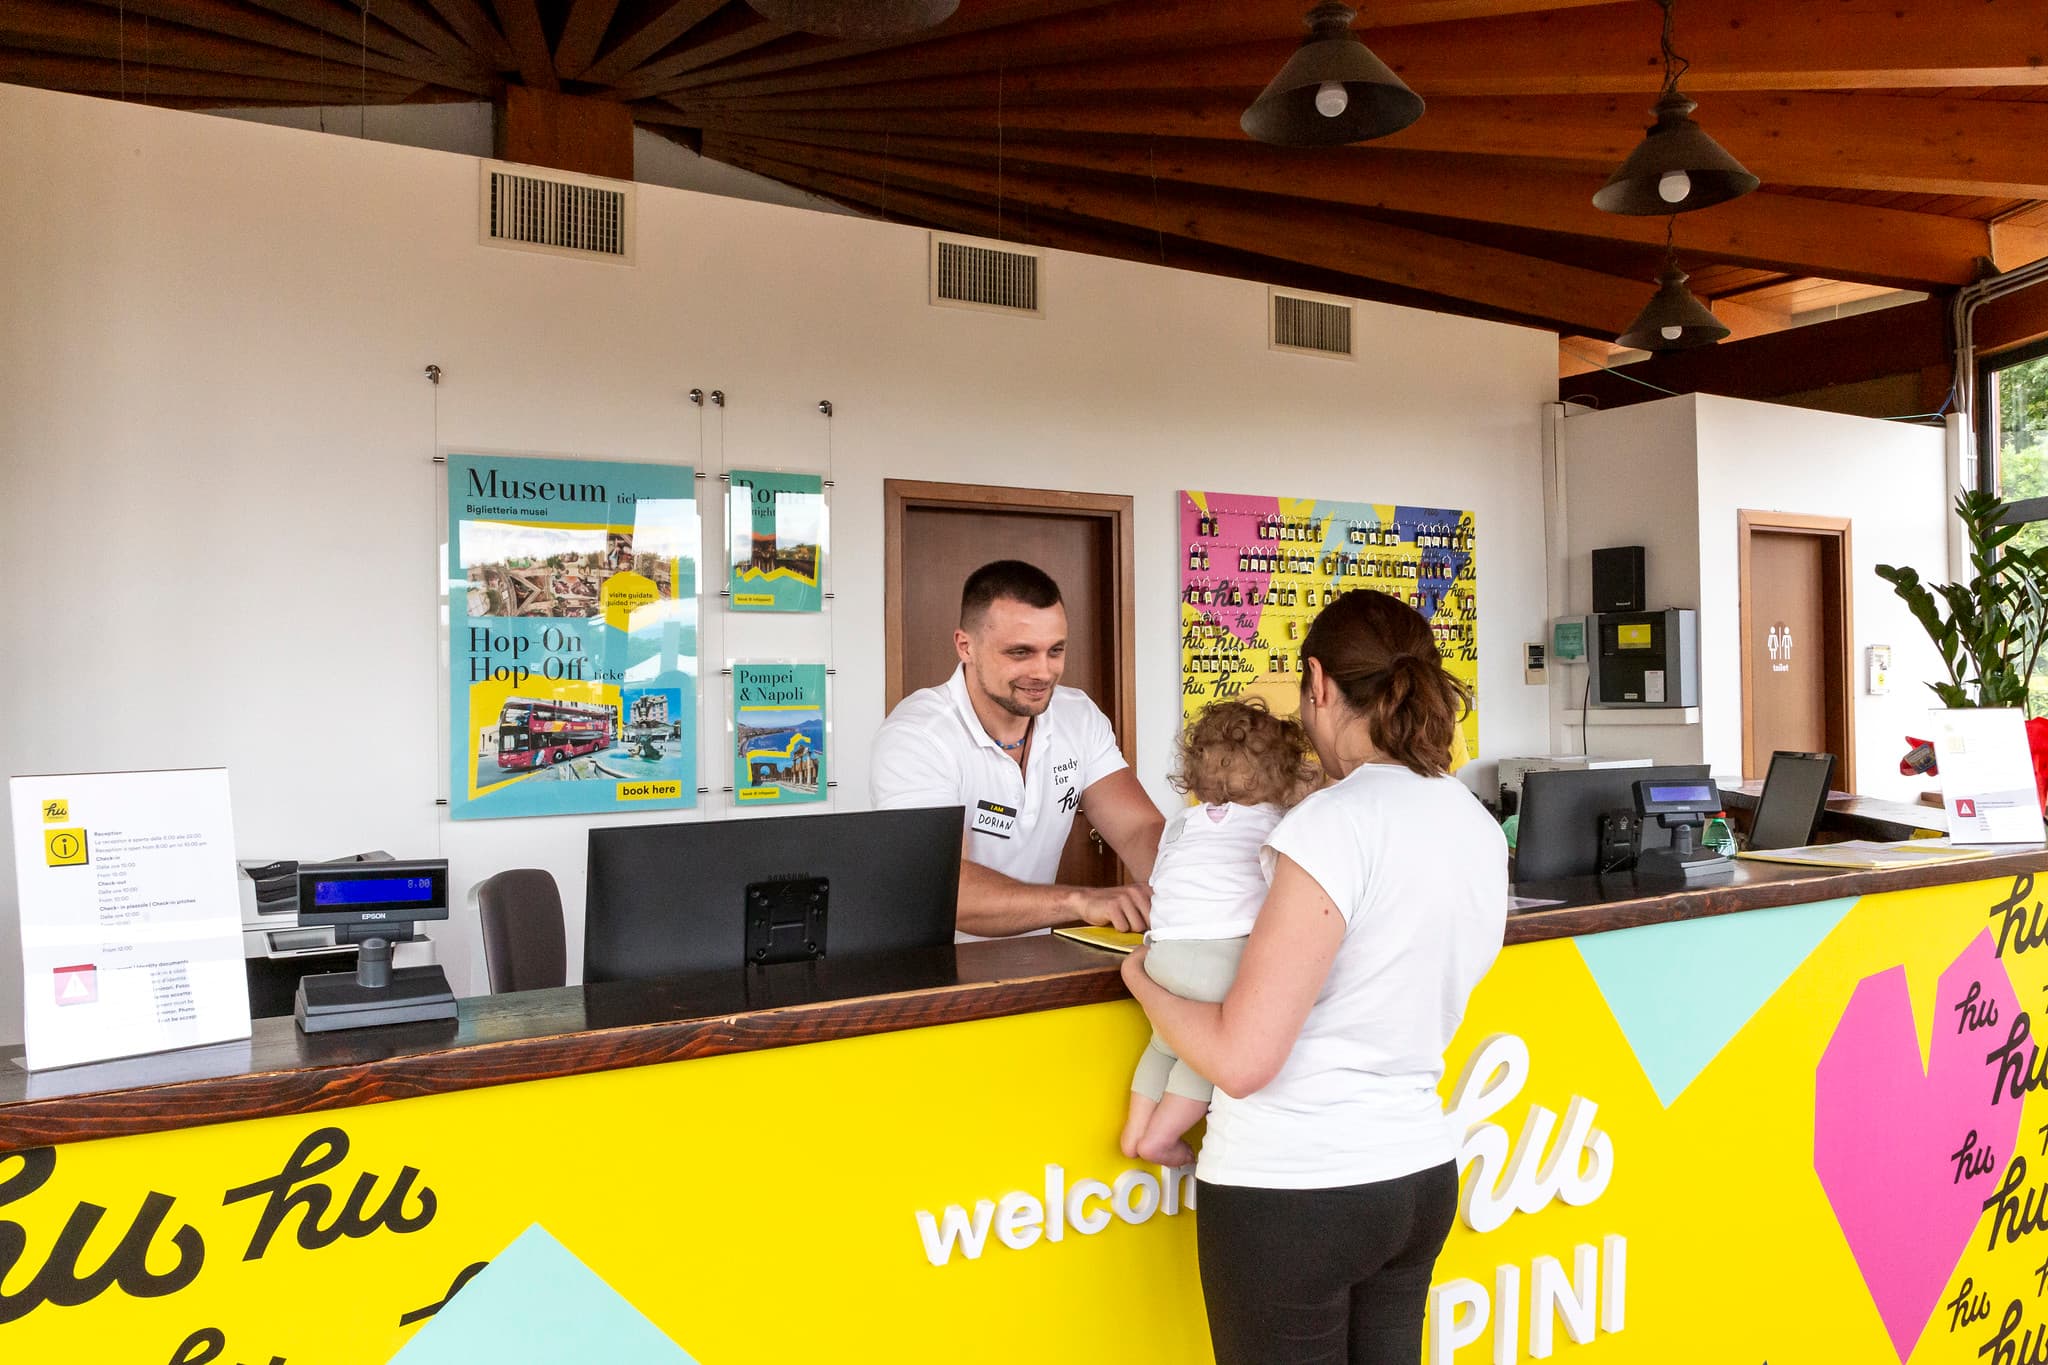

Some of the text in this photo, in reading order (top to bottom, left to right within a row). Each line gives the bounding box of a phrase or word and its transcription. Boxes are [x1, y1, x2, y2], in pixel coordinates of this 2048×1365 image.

[466, 468, 608, 502] Museum
[466, 504, 548, 516] Biglietteria musei
[1235, 613, 1254, 628] hu
[469, 626, 582, 660] Hop-On
[1248, 630, 1269, 649] hu
[1772, 663, 1789, 672] toilet
[740, 670, 793, 687] Pompei
[1182, 675, 1205, 695] hu
[740, 687, 803, 704] & Napoli
[1053, 758, 1078, 774] ready
[1054, 775, 1069, 785] for
[622, 783, 676, 796] book here
[43, 802, 67, 817] hu
[978, 813, 1014, 831] DORIAN
[361, 912, 386, 921] EPSON
[1954, 980, 1998, 1035] hu
[1443, 1032, 1614, 1233] hu
[1951, 1129, 1995, 1184] hu
[222, 1127, 437, 1262] hu
[1430, 1233, 1627, 1365] PINI
[1946, 1277, 1990, 1333] hu
